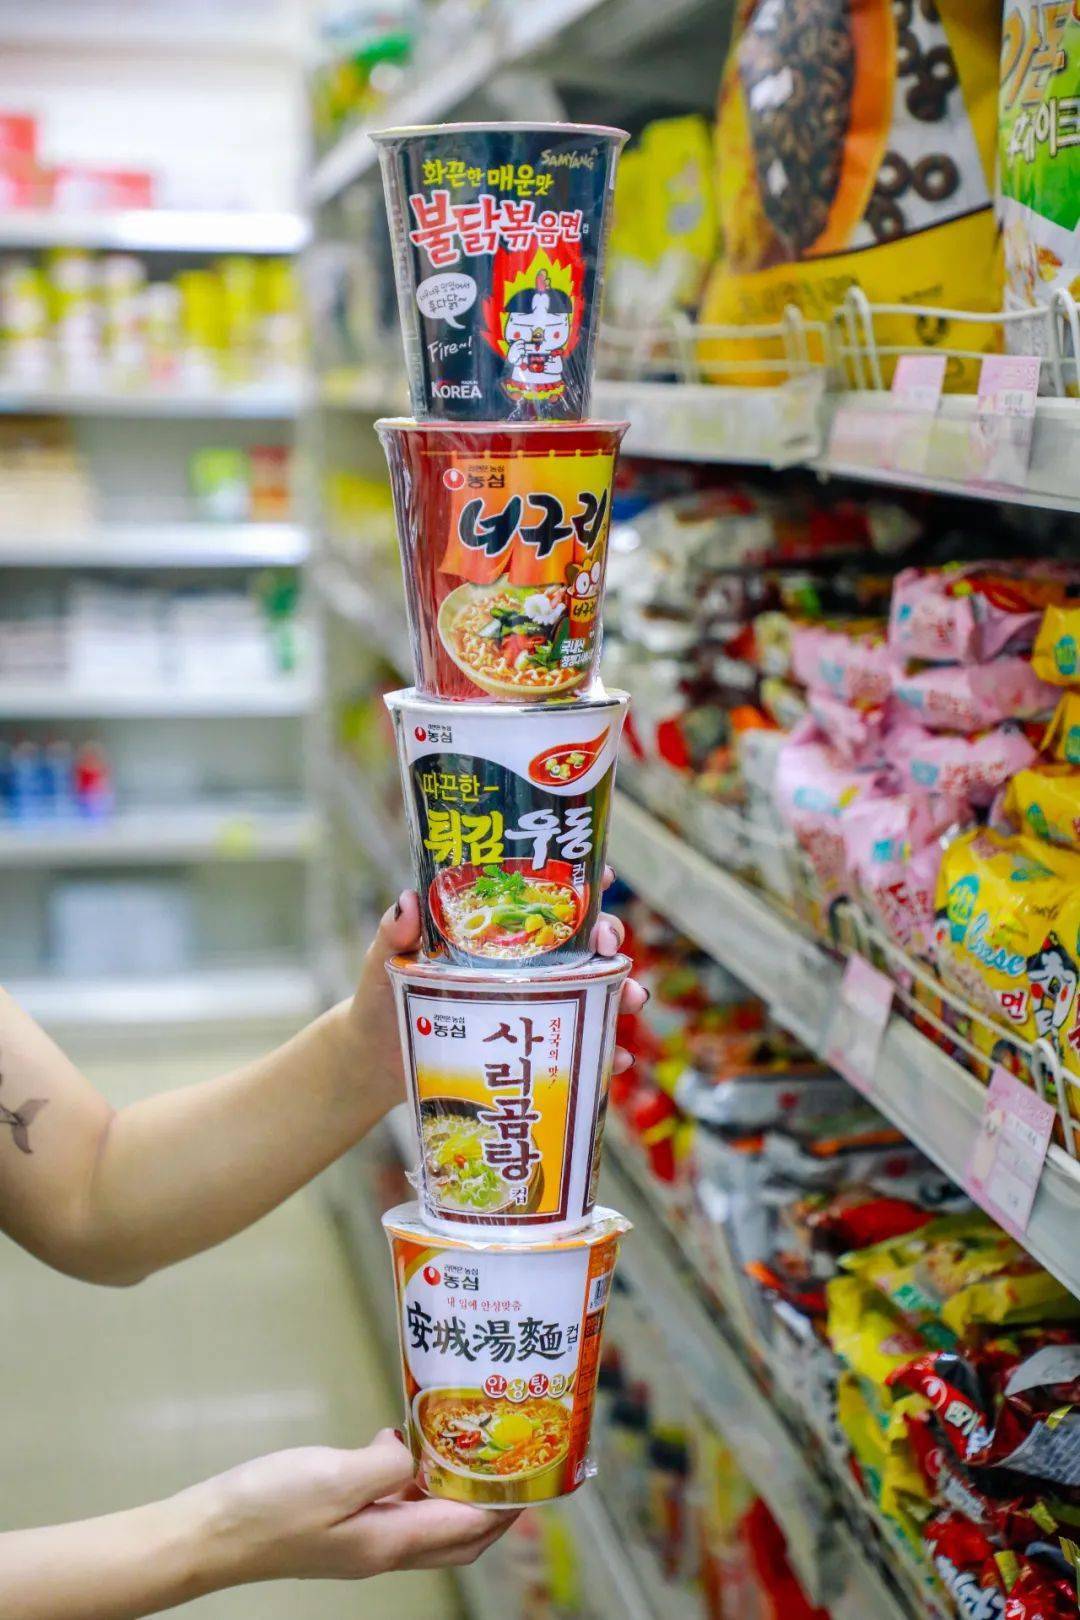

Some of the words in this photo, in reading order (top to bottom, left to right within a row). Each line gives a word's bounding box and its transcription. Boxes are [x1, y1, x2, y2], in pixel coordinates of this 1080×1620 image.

[422, 159, 485, 187] 화끈한
[487, 164, 554, 196] 매운맛
[409, 190, 582, 268] 불닭볶음면
[431, 382, 482, 399] KOREA
[468, 474, 504, 488] 농심
[458, 488, 607, 559] 너구리
[428, 731, 453, 743] 농심
[433, 1021, 466, 1039] 농심
[481, 1016, 545, 1182] 사리곰탕
[443, 1273, 479, 1291] 농심
[406, 1301, 565, 1363] 安城湯麵
[566, 1323, 579, 1344] 컵
[487, 1374, 567, 1400] 안성탕면
